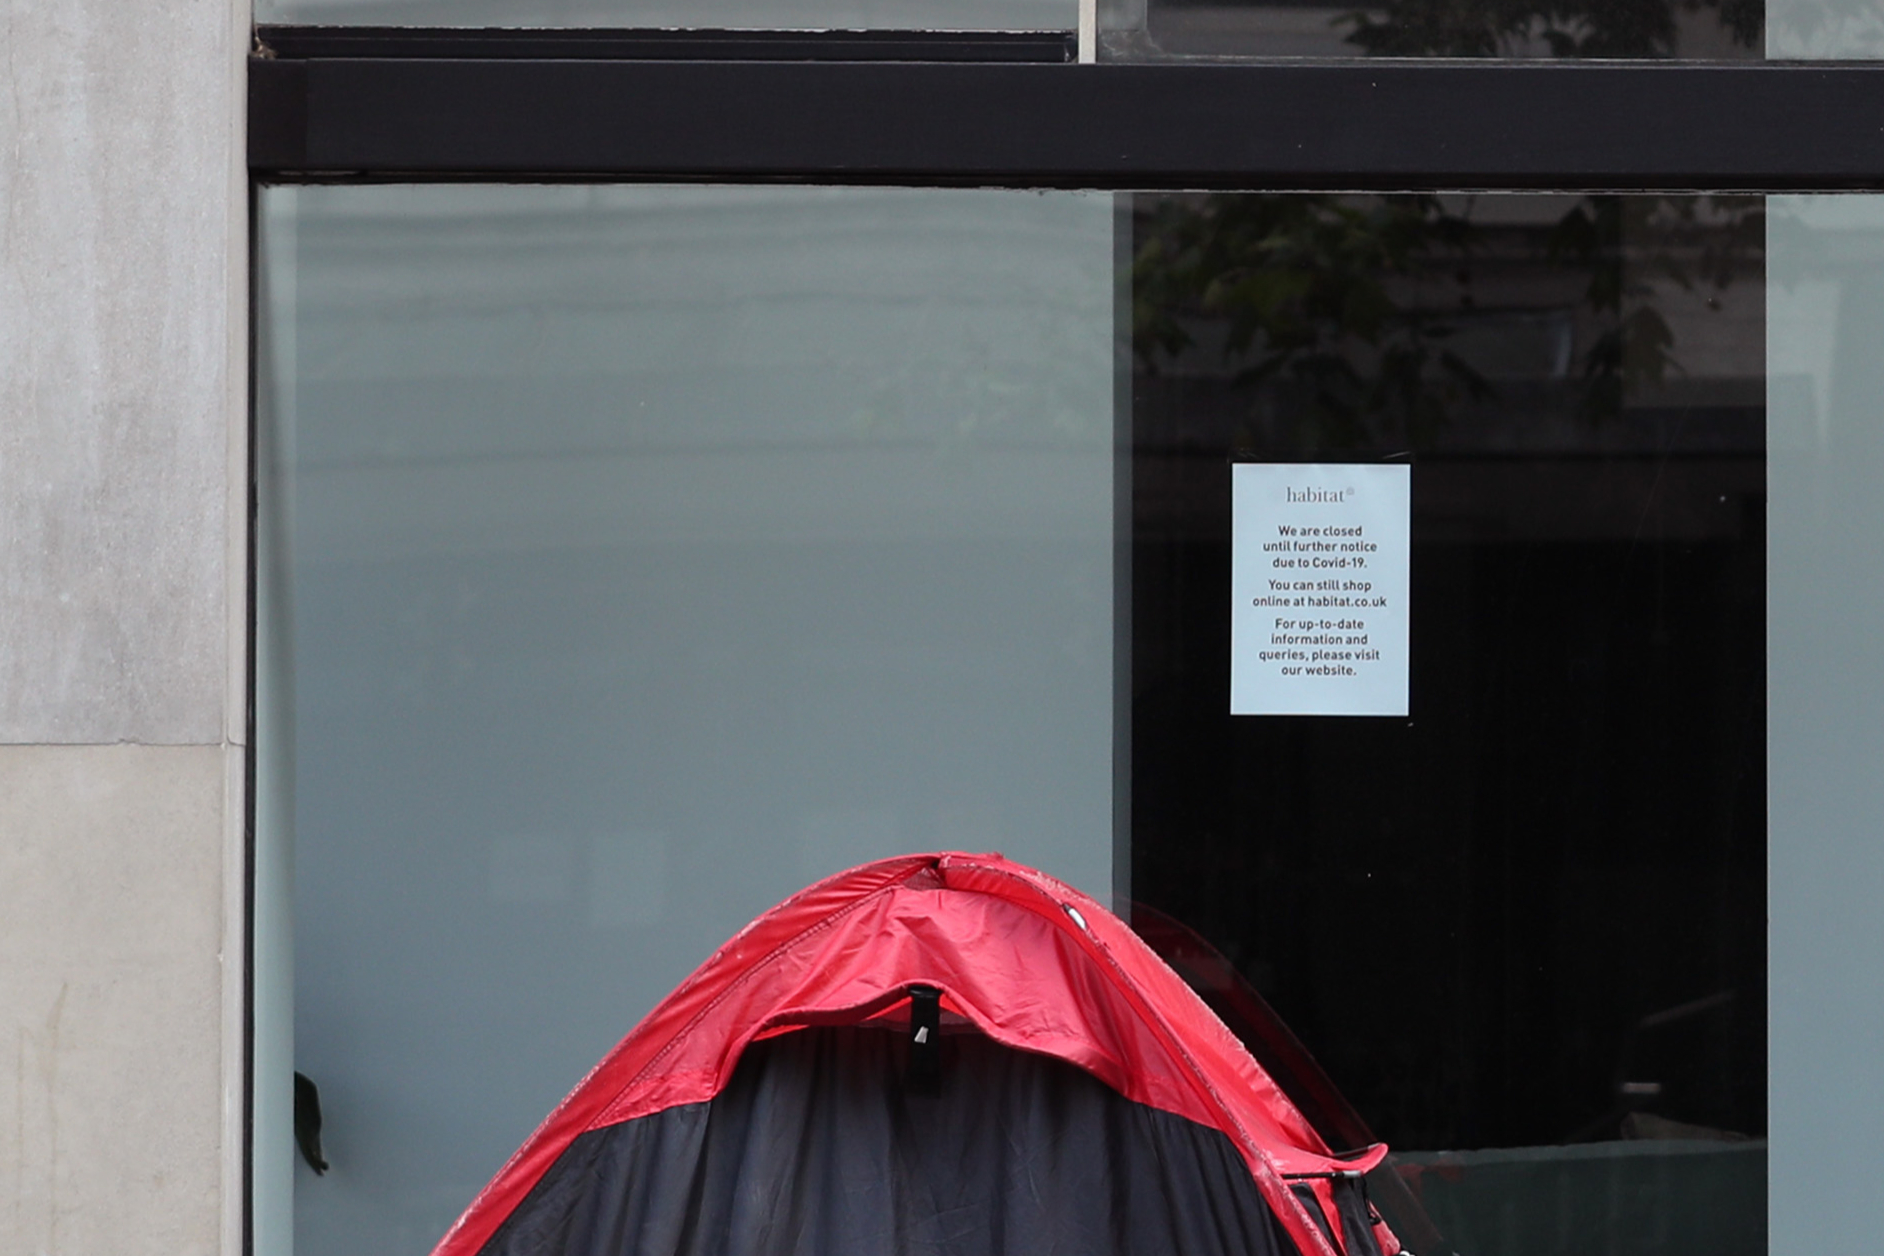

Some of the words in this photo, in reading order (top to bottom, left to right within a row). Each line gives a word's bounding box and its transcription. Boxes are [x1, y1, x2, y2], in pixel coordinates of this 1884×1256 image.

[1278, 525, 1298, 537] We
[1299, 528, 1321, 537] are
[1322, 525, 1363, 537] closed
[1262, 540, 1292, 552] until
[1293, 540, 1338, 552] further
[1339, 540, 1378, 552] notice
[1272, 556, 1296, 568] due
[1297, 556, 1311, 568] to
[1311, 556, 1368, 568] Covid-19.
[1268, 579, 1291, 591] You
[1292, 582, 1315, 591] can
[1316, 579, 1341, 591] still
[1342, 579, 1373, 593] shop
[1252, 595, 1291, 608] online
[1292, 595, 1305, 608] at
[1307, 595, 1388, 608] habitat.co.uk
[1274, 618, 1297, 630] For
[1298, 618, 1365, 631] up-to-date
[1270, 633, 1344, 646] information
[1345, 633, 1369, 646] and
[1258, 649, 1310, 663] queries,
[1311, 649, 1353, 663] please
[1353, 649, 1380, 661] visit
[1281, 667, 1304, 676] our
[1304, 664, 1357, 676] website.
